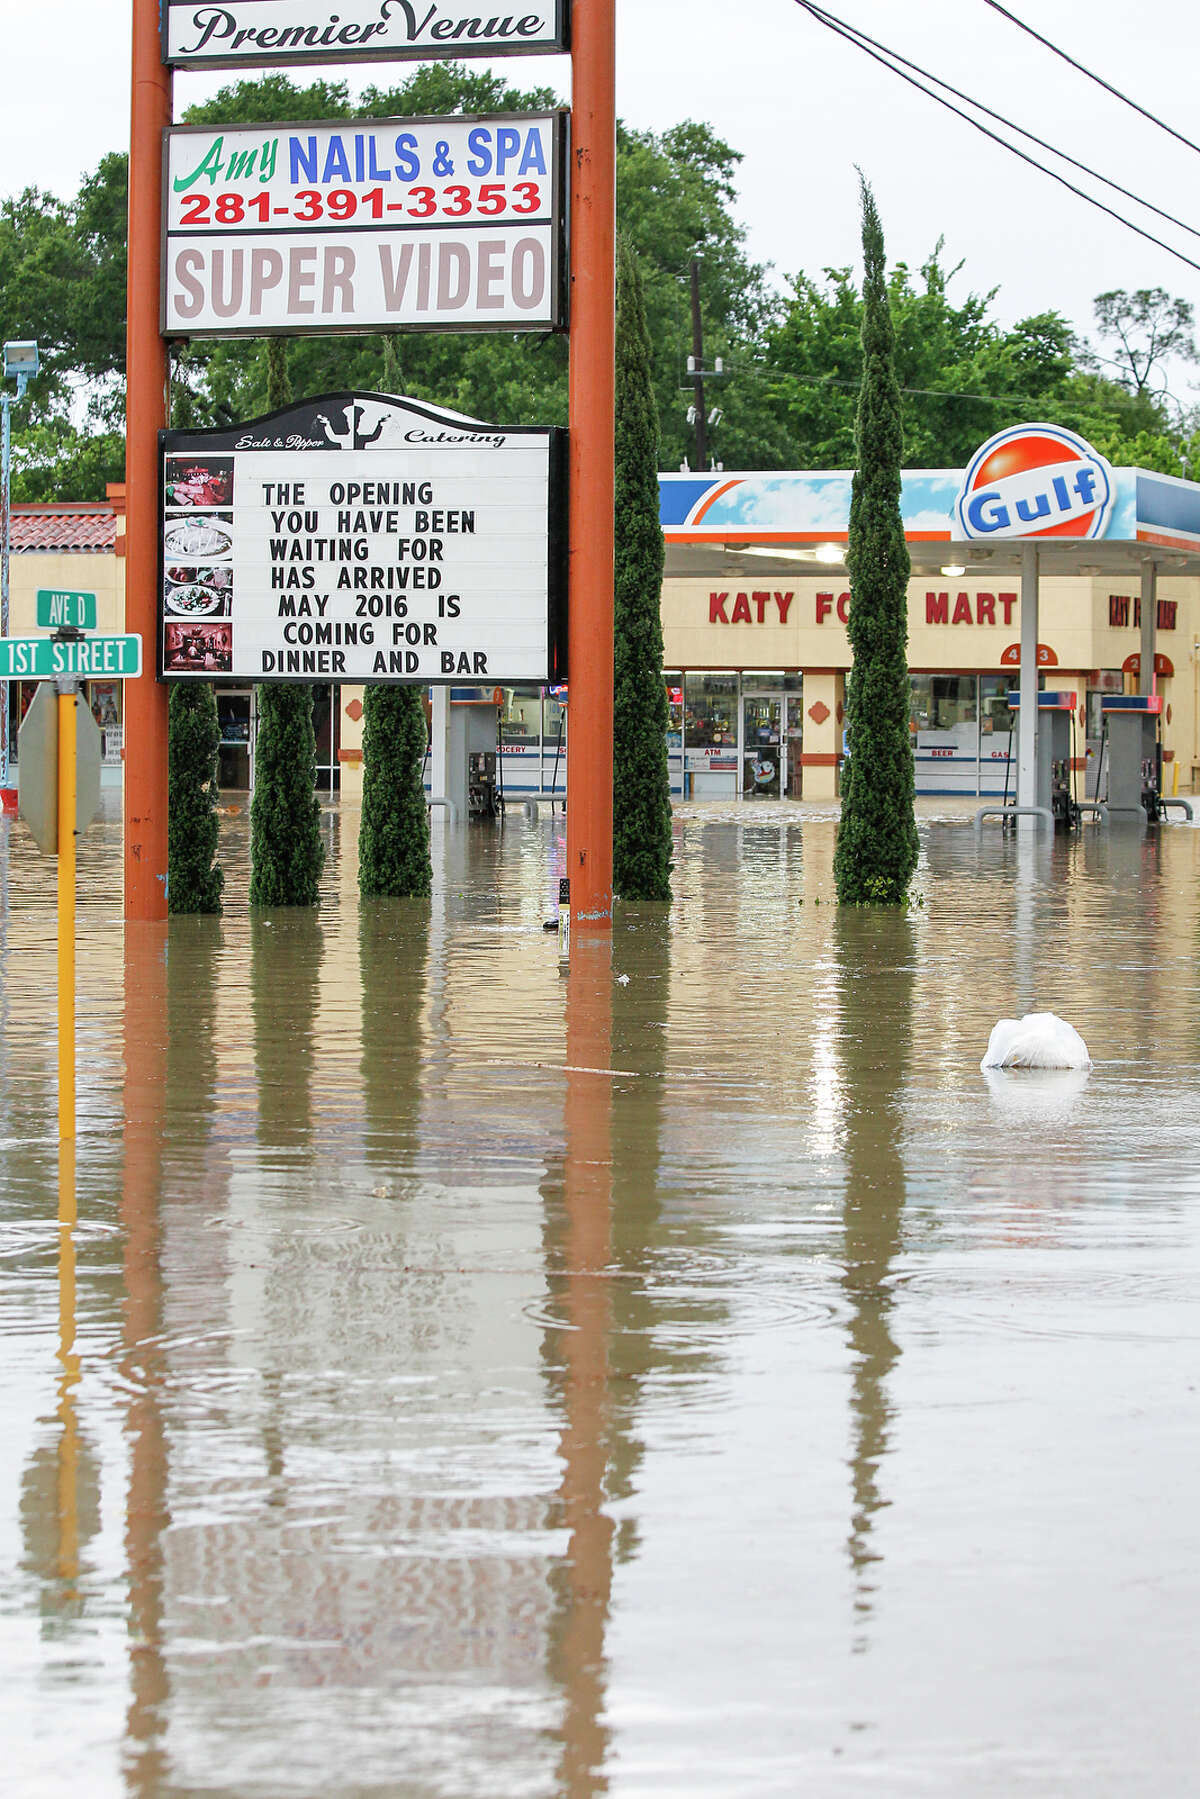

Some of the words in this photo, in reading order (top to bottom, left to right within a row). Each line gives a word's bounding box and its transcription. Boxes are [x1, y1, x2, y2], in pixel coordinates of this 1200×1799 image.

[179, 8, 389, 53] Premier
[380, 0, 545, 42] Venue
[173, 136, 279, 193] Amy
[289, 133, 420, 185] NAILS
[432, 140, 455, 177] &
[468, 128, 547, 177] SPA
[179, 182, 541, 225] 281-391-3353
[173, 246, 356, 319] SUPER
[378, 237, 546, 313] VIDEO
[234, 435, 271, 449] Salt
[274, 437, 285, 447] &
[404, 429, 506, 448] Catering
[262, 483, 305, 506] THE
[329, 482, 433, 506] OPENING
[967, 468, 1096, 533] Gulf
[271, 511, 319, 534] YOU
[337, 511, 399, 533] HAVE
[415, 511, 475, 534] BEEN
[269, 539, 369, 562] WAITING
[398, 539, 444, 561] FOR
[271, 567, 315, 589] HAS
[337, 567, 442, 590] ARRIVED
[50, 595, 71, 625] AVE
[78, 596, 86, 626] D
[277, 595, 330, 617] MAY
[355, 595, 408, 618] 2016
[437, 595, 461, 618] IS
[709, 592, 794, 625] KATY
[925, 592, 1017, 625] MART
[283, 622, 375, 646] COMING
[392, 622, 438, 646] FOR
[8, 643, 39, 673] 1ST
[52, 641, 127, 672] STREET
[261, 650, 346, 673] DINNER
[372, 651, 420, 674] AND
[440, 651, 488, 675] BAR
[1008, 648, 1018, 660] 4
[1039, 649, 1049, 661] 3
[1130, 658, 1139, 669] 2
